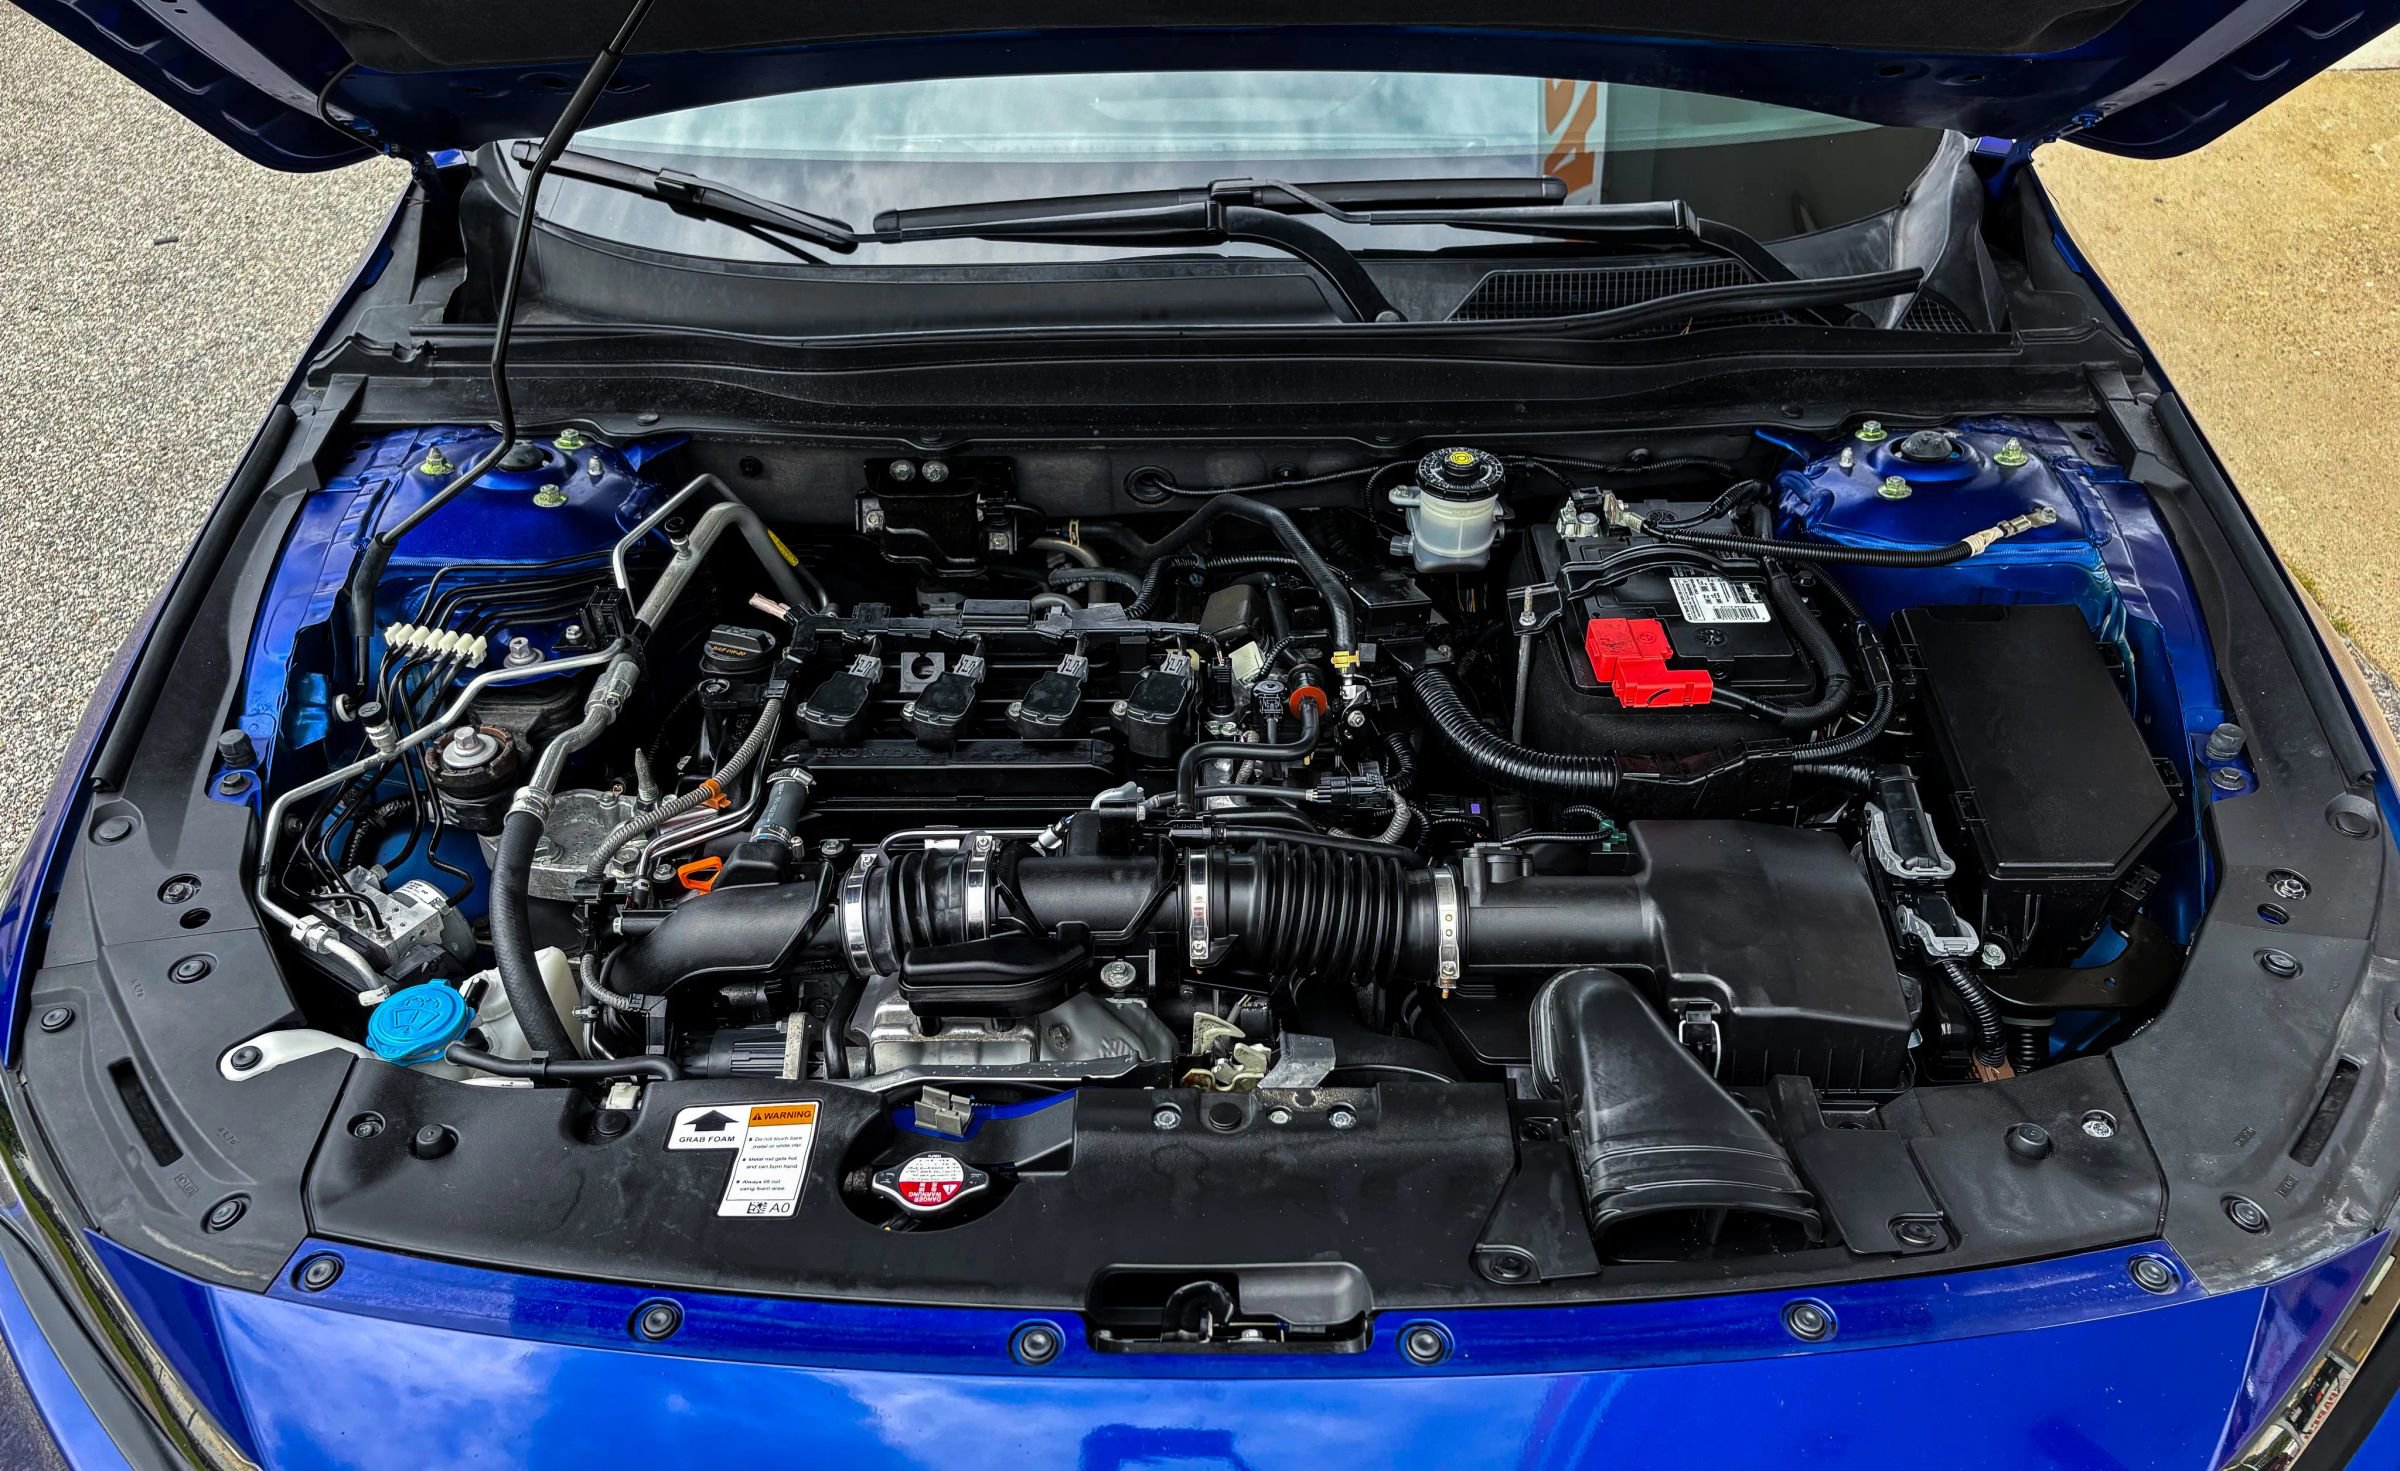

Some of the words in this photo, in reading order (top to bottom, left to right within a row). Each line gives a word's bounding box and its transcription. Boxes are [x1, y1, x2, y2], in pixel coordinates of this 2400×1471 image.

[815, 747, 929, 758] HONDA
[763, 1110, 812, 1120] WARNING
[769, 1202, 790, 1213] A0
